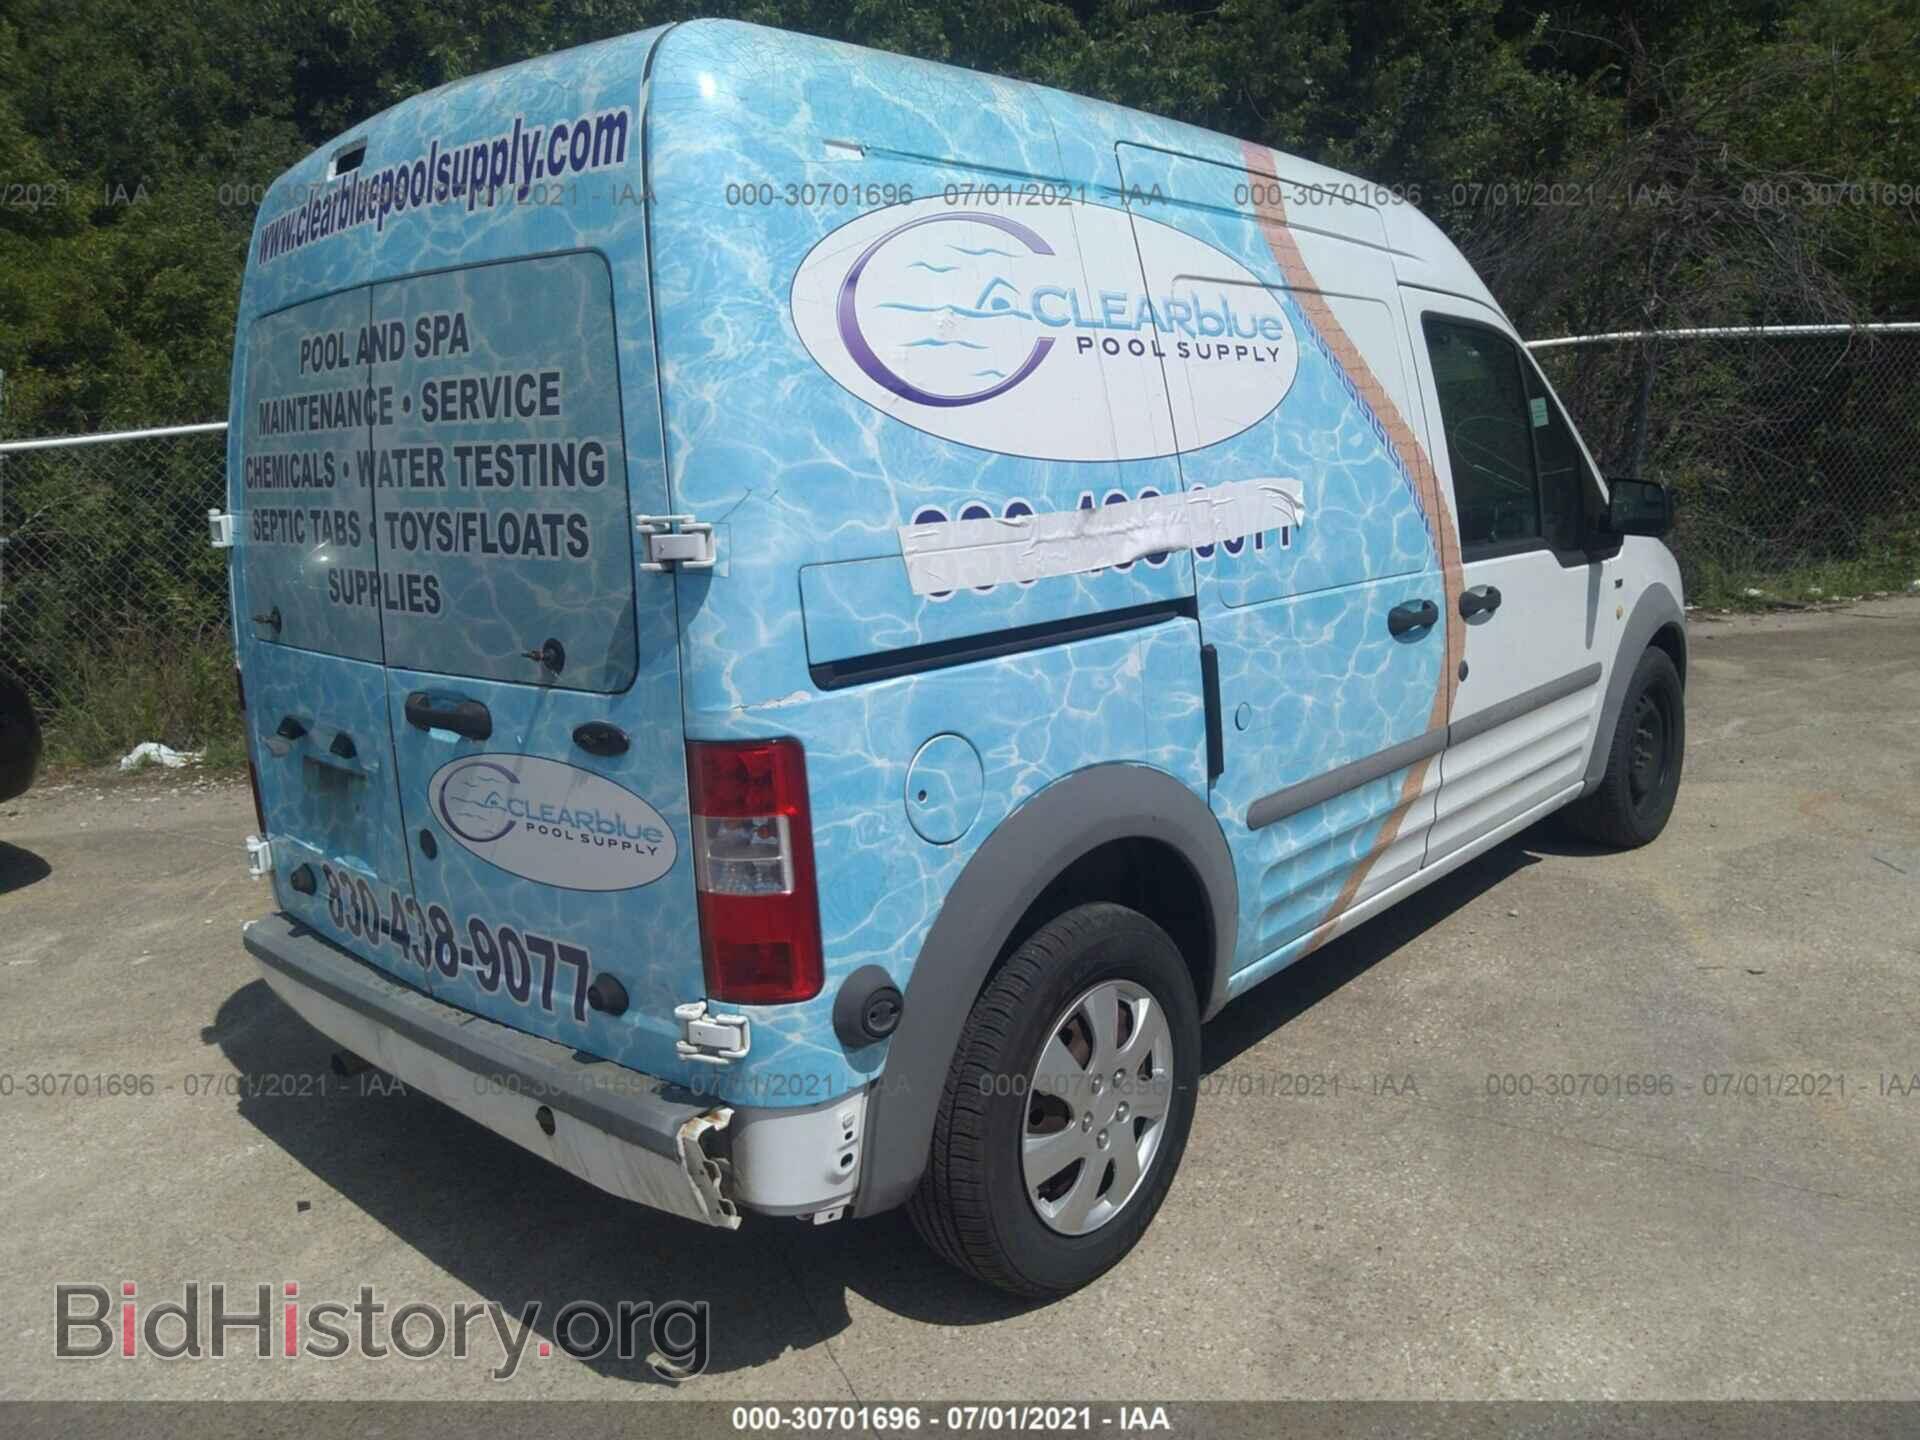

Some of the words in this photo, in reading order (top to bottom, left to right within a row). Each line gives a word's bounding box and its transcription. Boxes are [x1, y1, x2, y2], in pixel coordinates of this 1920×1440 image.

[257, 109, 628, 264] www.clearbluepoolsupply.com
[300, 332, 350, 375] POOL
[356, 321, 406, 364] AND
[414, 312, 470, 358] SPA
[1078, 336, 1166, 358] POOL
[1178, 341, 1281, 363] SUPPLY
[258, 386, 393, 435] MAINTENANCE
[421, 371, 561, 422] SERVICE
[245, 451, 335, 489] CHEMICALS
[357, 447, 446, 488] WATER
[454, 441, 605, 487] TESTING
[252, 509, 305, 543] SEPTIC
[310, 509, 361, 548] TABS
[384, 511, 590, 558] TOYS/FLOATS
[328, 568, 441, 615] SUPPLIES
[526, 822, 574, 841] POOL
[580, 832, 658, 857] SUPPLY
[322, 863, 591, 1023] 830-438-9077
